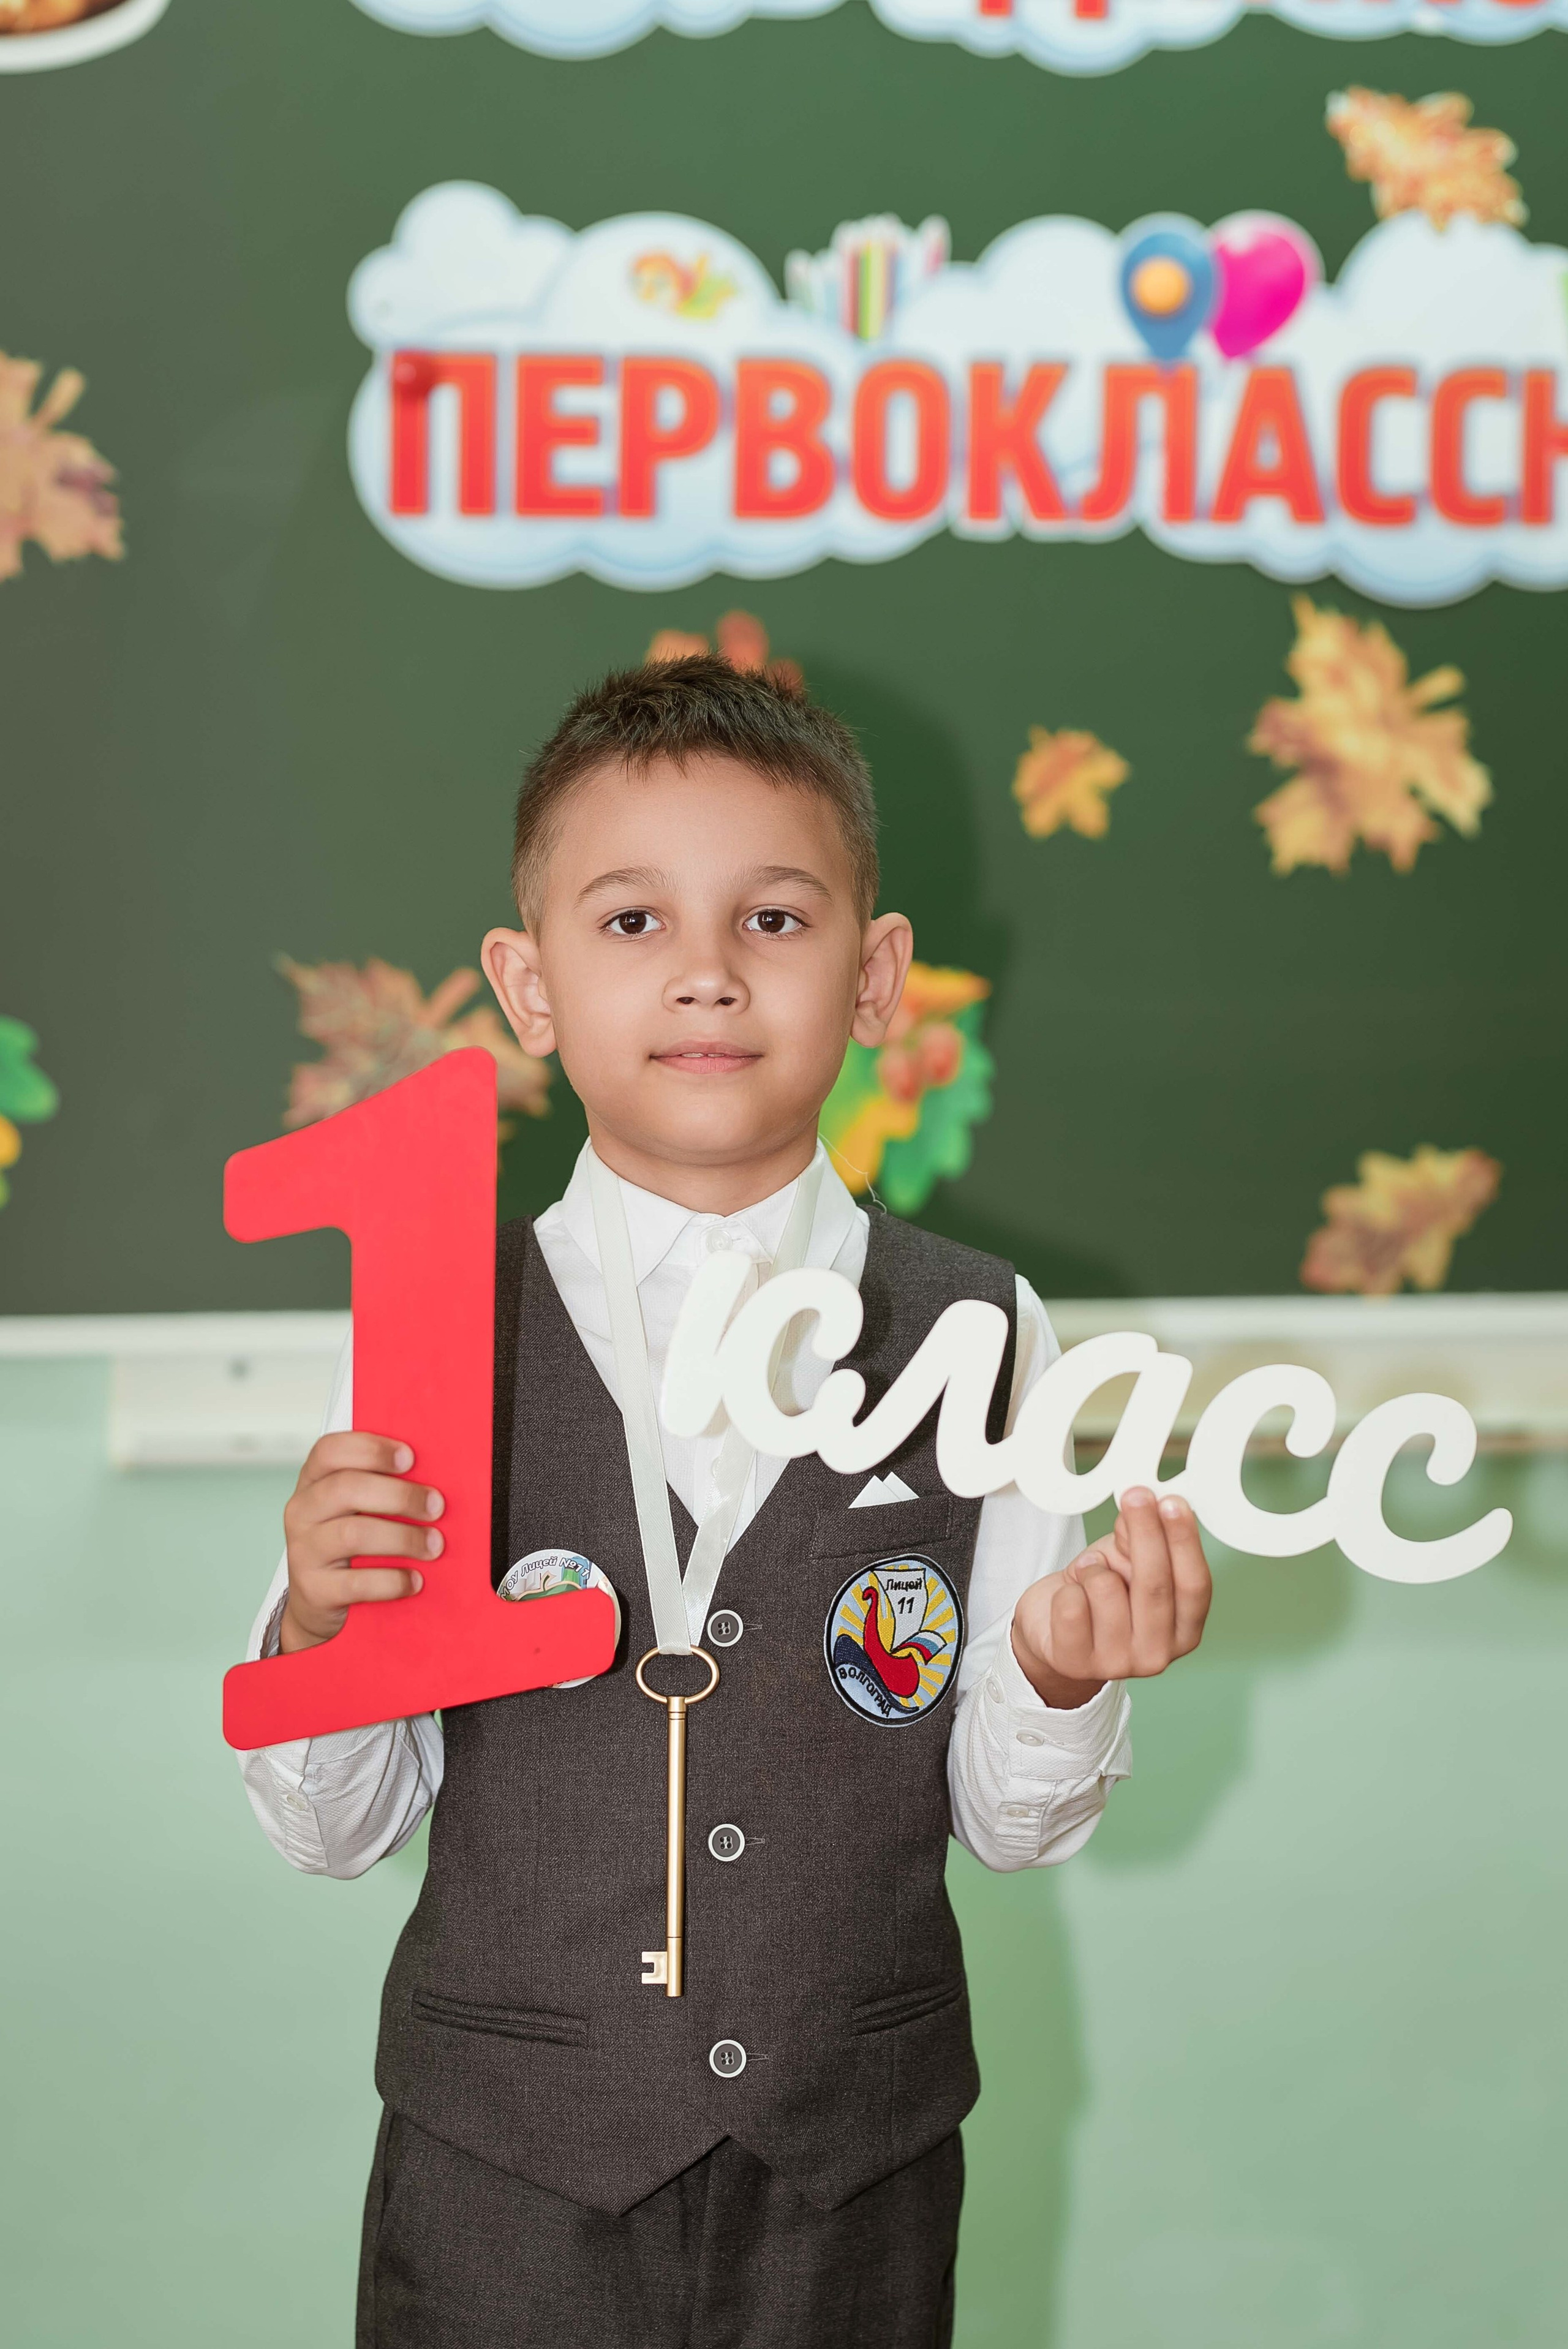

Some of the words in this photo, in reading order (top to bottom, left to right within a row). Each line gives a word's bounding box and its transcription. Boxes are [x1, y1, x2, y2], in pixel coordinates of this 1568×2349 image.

[223, 1047, 616, 1750] 1
[500, 1570, 519, 1601] МОУ
[521, 1556, 557, 1577] Лицей
[559, 1557, 590, 1580] №11
[885, 1577, 922, 1592] Лицей
[897, 1597, 914, 1613] 11
[839, 1667, 892, 1717] ВОЛГОГРАД
